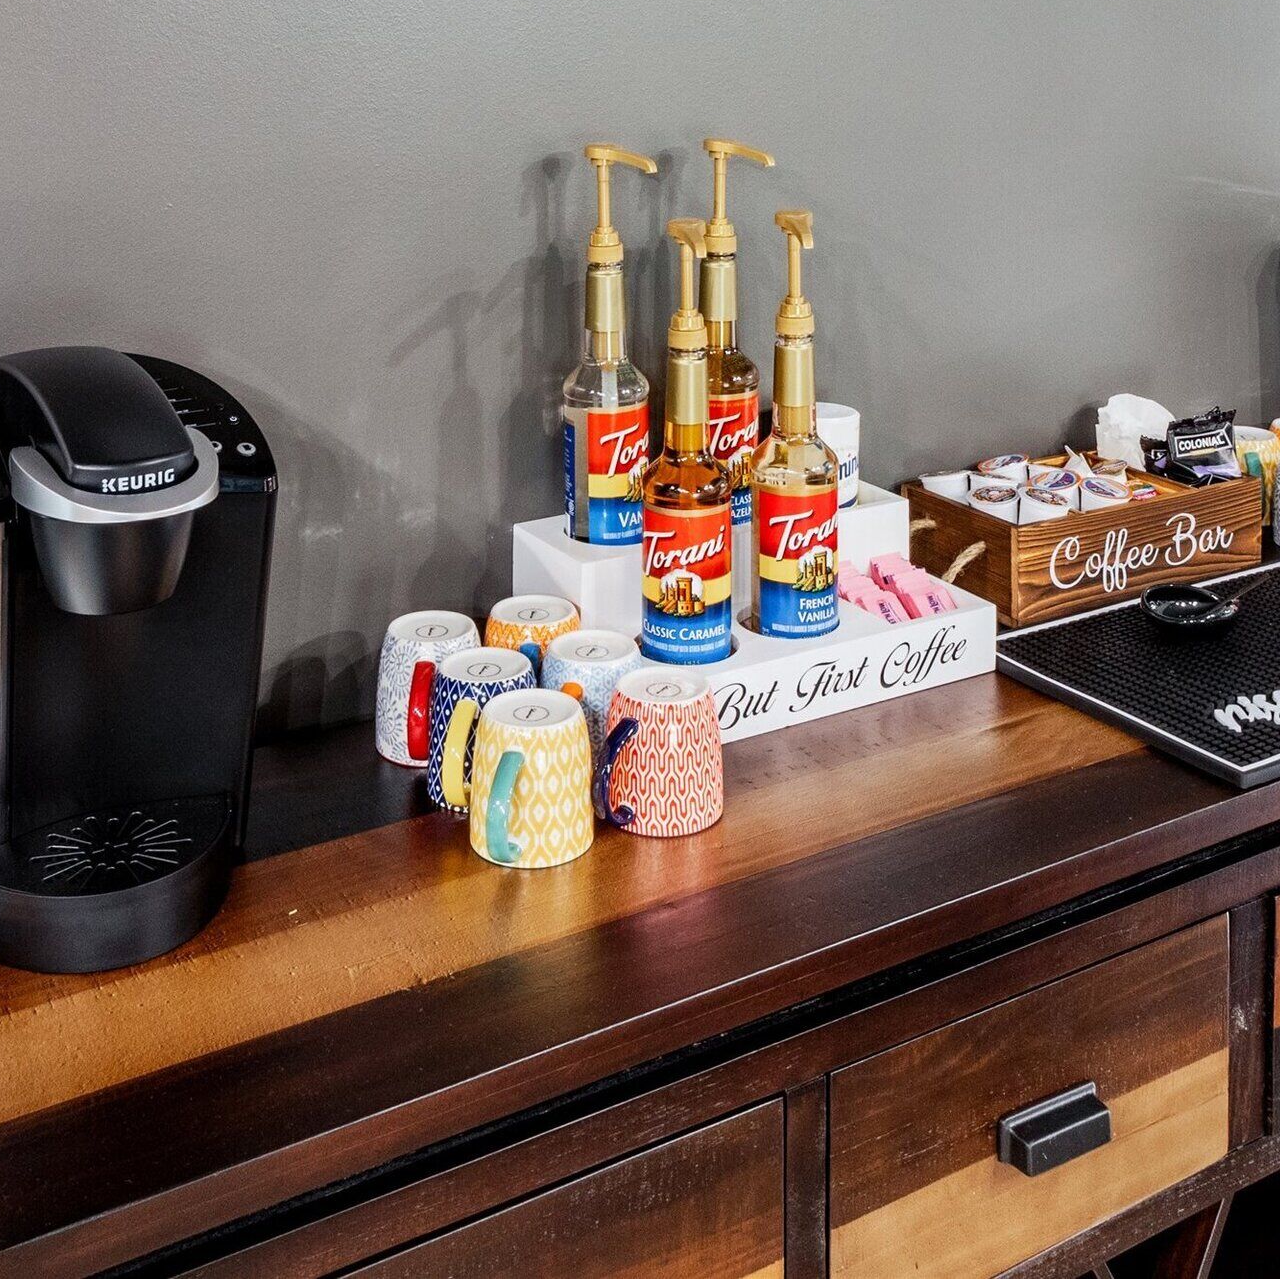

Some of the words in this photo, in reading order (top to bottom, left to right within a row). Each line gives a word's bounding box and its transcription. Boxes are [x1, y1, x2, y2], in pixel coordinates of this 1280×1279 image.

[1178, 431, 1225, 452] COLONIAL
[101, 468, 174, 493] KEURIG
[643, 525, 726, 577] Torani
[1049, 528, 1159, 593] Coffee
[1164, 512, 1234, 566] Bar
[800, 594, 834, 610] FRENCH
[797, 609, 835, 623] VANILLA
[643, 618, 677, 640] CLASSIC
[679, 623, 726, 641] CARAMEL
[713, 680, 780, 731] But
[789, 657, 870, 713] First
[880, 625, 967, 688] Coffee
